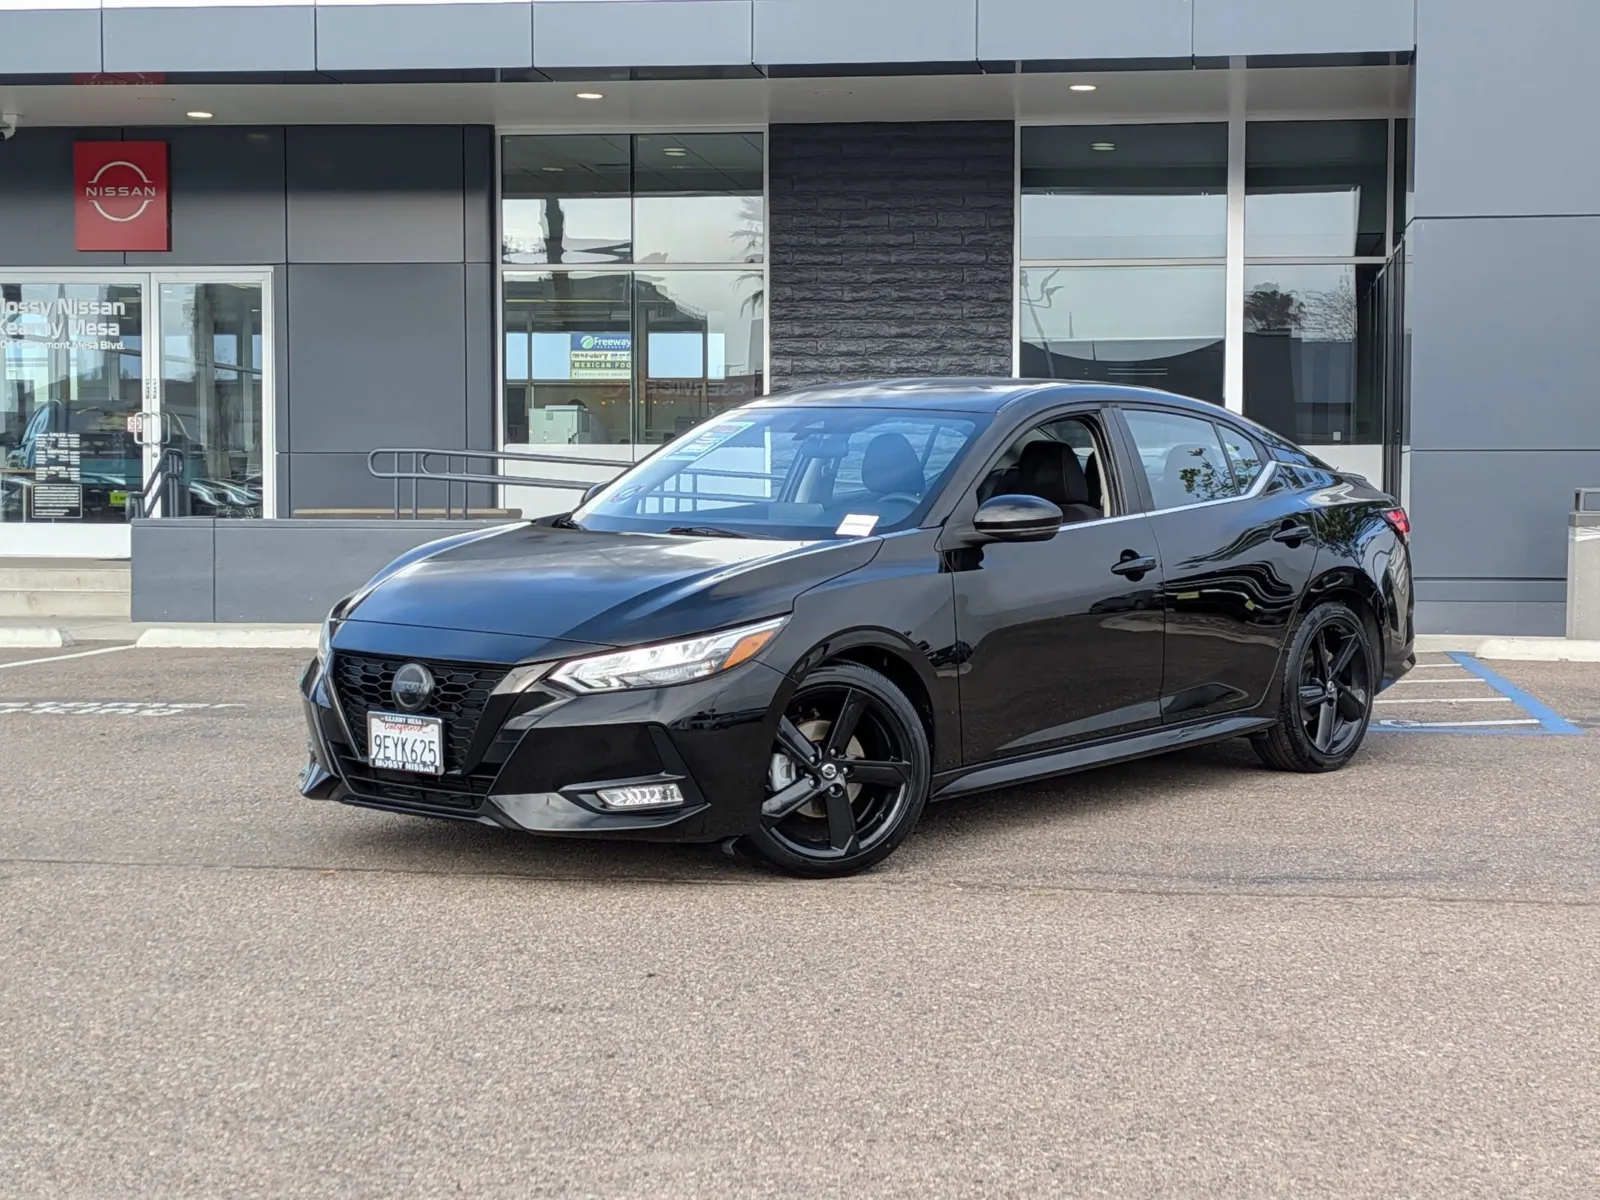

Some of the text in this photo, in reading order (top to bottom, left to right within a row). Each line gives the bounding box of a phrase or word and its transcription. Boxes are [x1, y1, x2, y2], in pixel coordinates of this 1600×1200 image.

[86, 186, 156, 197] NISSAN
[57, 298, 125, 315] Nissan
[68, 319, 120, 337] Mesa
[100, 340, 126, 350] Blvd.
[594, 336, 631, 348] Freeway
[374, 735, 436, 764] 9EYK625
[375, 760, 435, 773] MOSSY NISSAN
